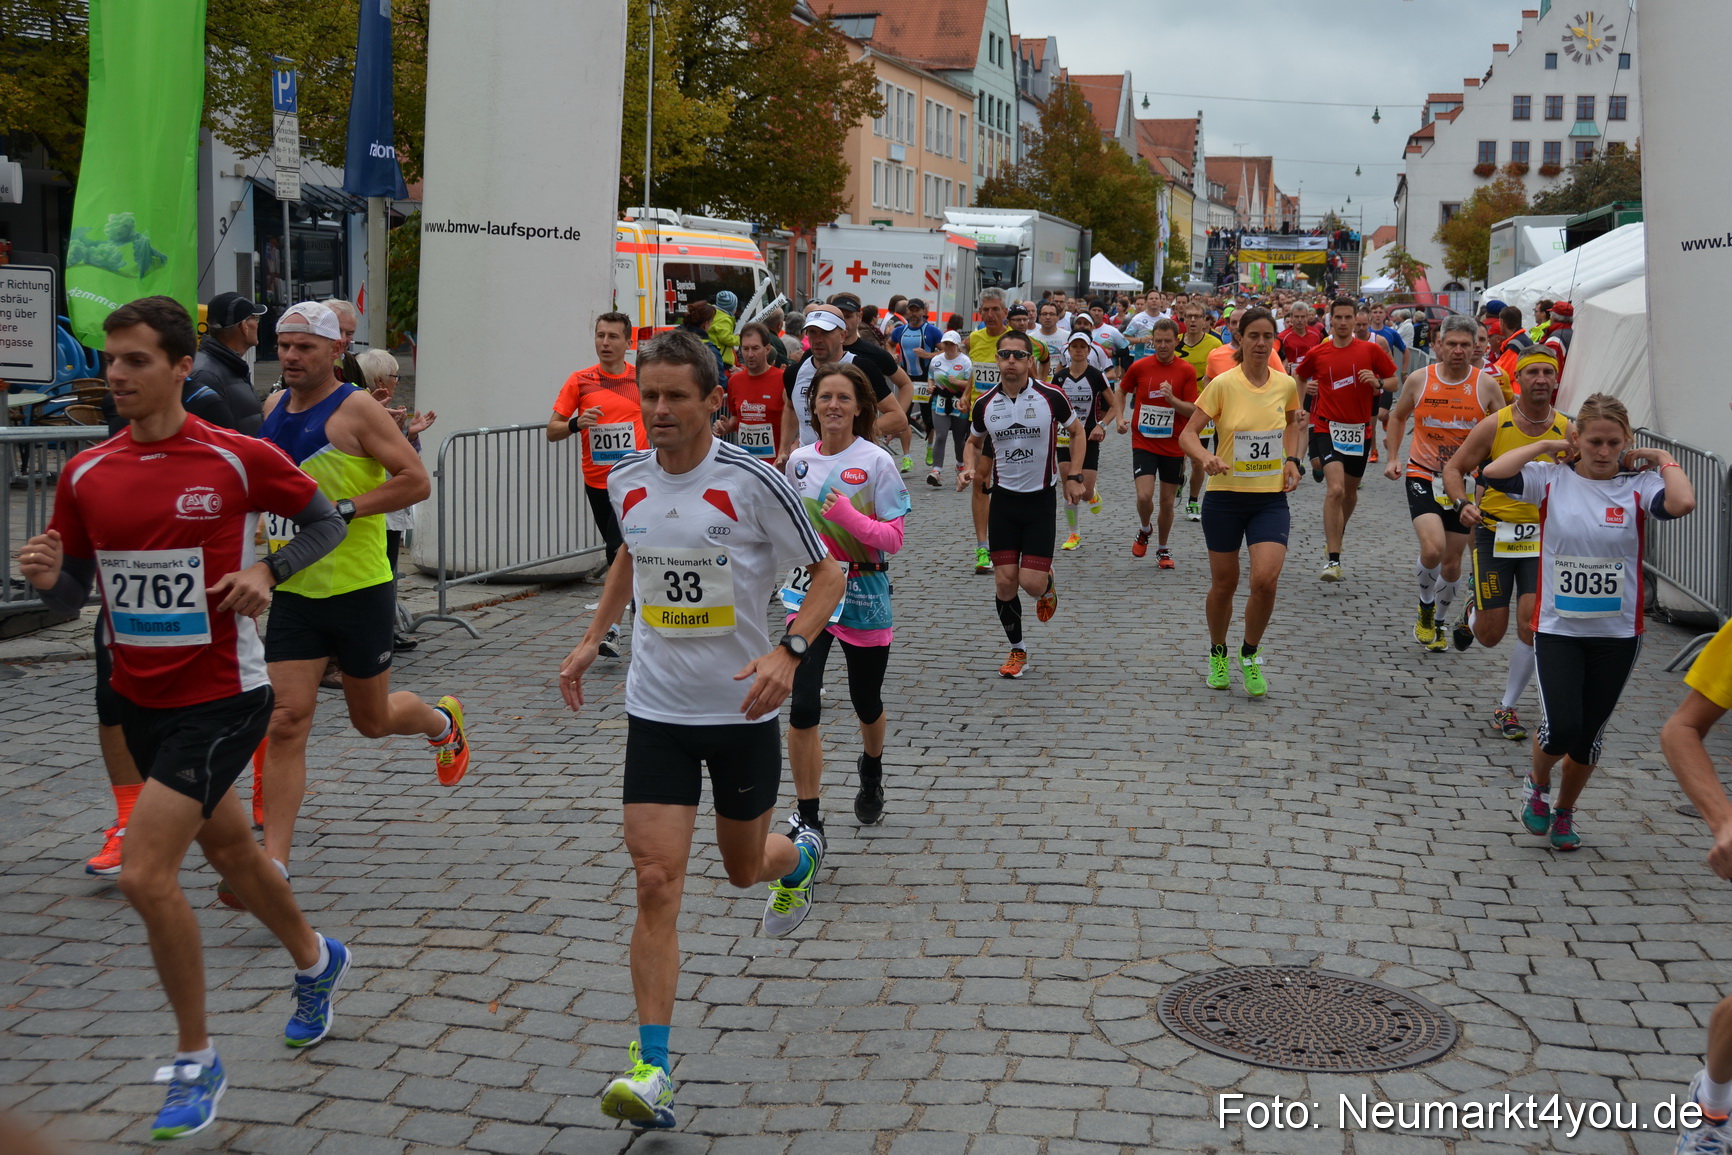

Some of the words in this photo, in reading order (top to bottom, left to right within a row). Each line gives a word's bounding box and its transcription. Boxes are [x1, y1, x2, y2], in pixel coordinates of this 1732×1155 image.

[220, 216, 228, 236] 3
[425, 218, 581, 241] www.bmw-laufsport.de
[1266, 253, 1297, 261] START
[872, 261, 914, 270] Bayerisches
[7, 279, 50, 292] Richtung
[15, 308, 37, 318] über
[975, 369, 1001, 382] 2137
[1142, 412, 1171, 426] 2677
[740, 431, 770, 446] 2676
[995, 428, 1041, 438] WOLFRUM
[1333, 429, 1362, 443] 2335
[593, 432, 632, 450] 2012
[1250, 442, 1270, 459] 34
[1245, 463, 1272, 471] Stefanie
[844, 471, 865, 481] Hervis
[1514, 523, 1536, 541] 92
[1507, 544, 1535, 552] Michael
[101, 558, 131, 568] PARTL
[133, 559, 184, 570] Neumarkt
[637, 556, 666, 566] PARTL
[667, 557, 713, 567] Neumarkt
[1555, 559, 1578, 569] PARTL
[1579, 562, 1613, 570] Neumarkt
[663, 570, 703, 603] 33
[1560, 570, 1618, 595] 3035
[112, 572, 196, 610] 2762
[845, 598, 873, 609] Stadtlauf
[662, 611, 710, 625] Richard
[129, 617, 182, 633] Thomas
